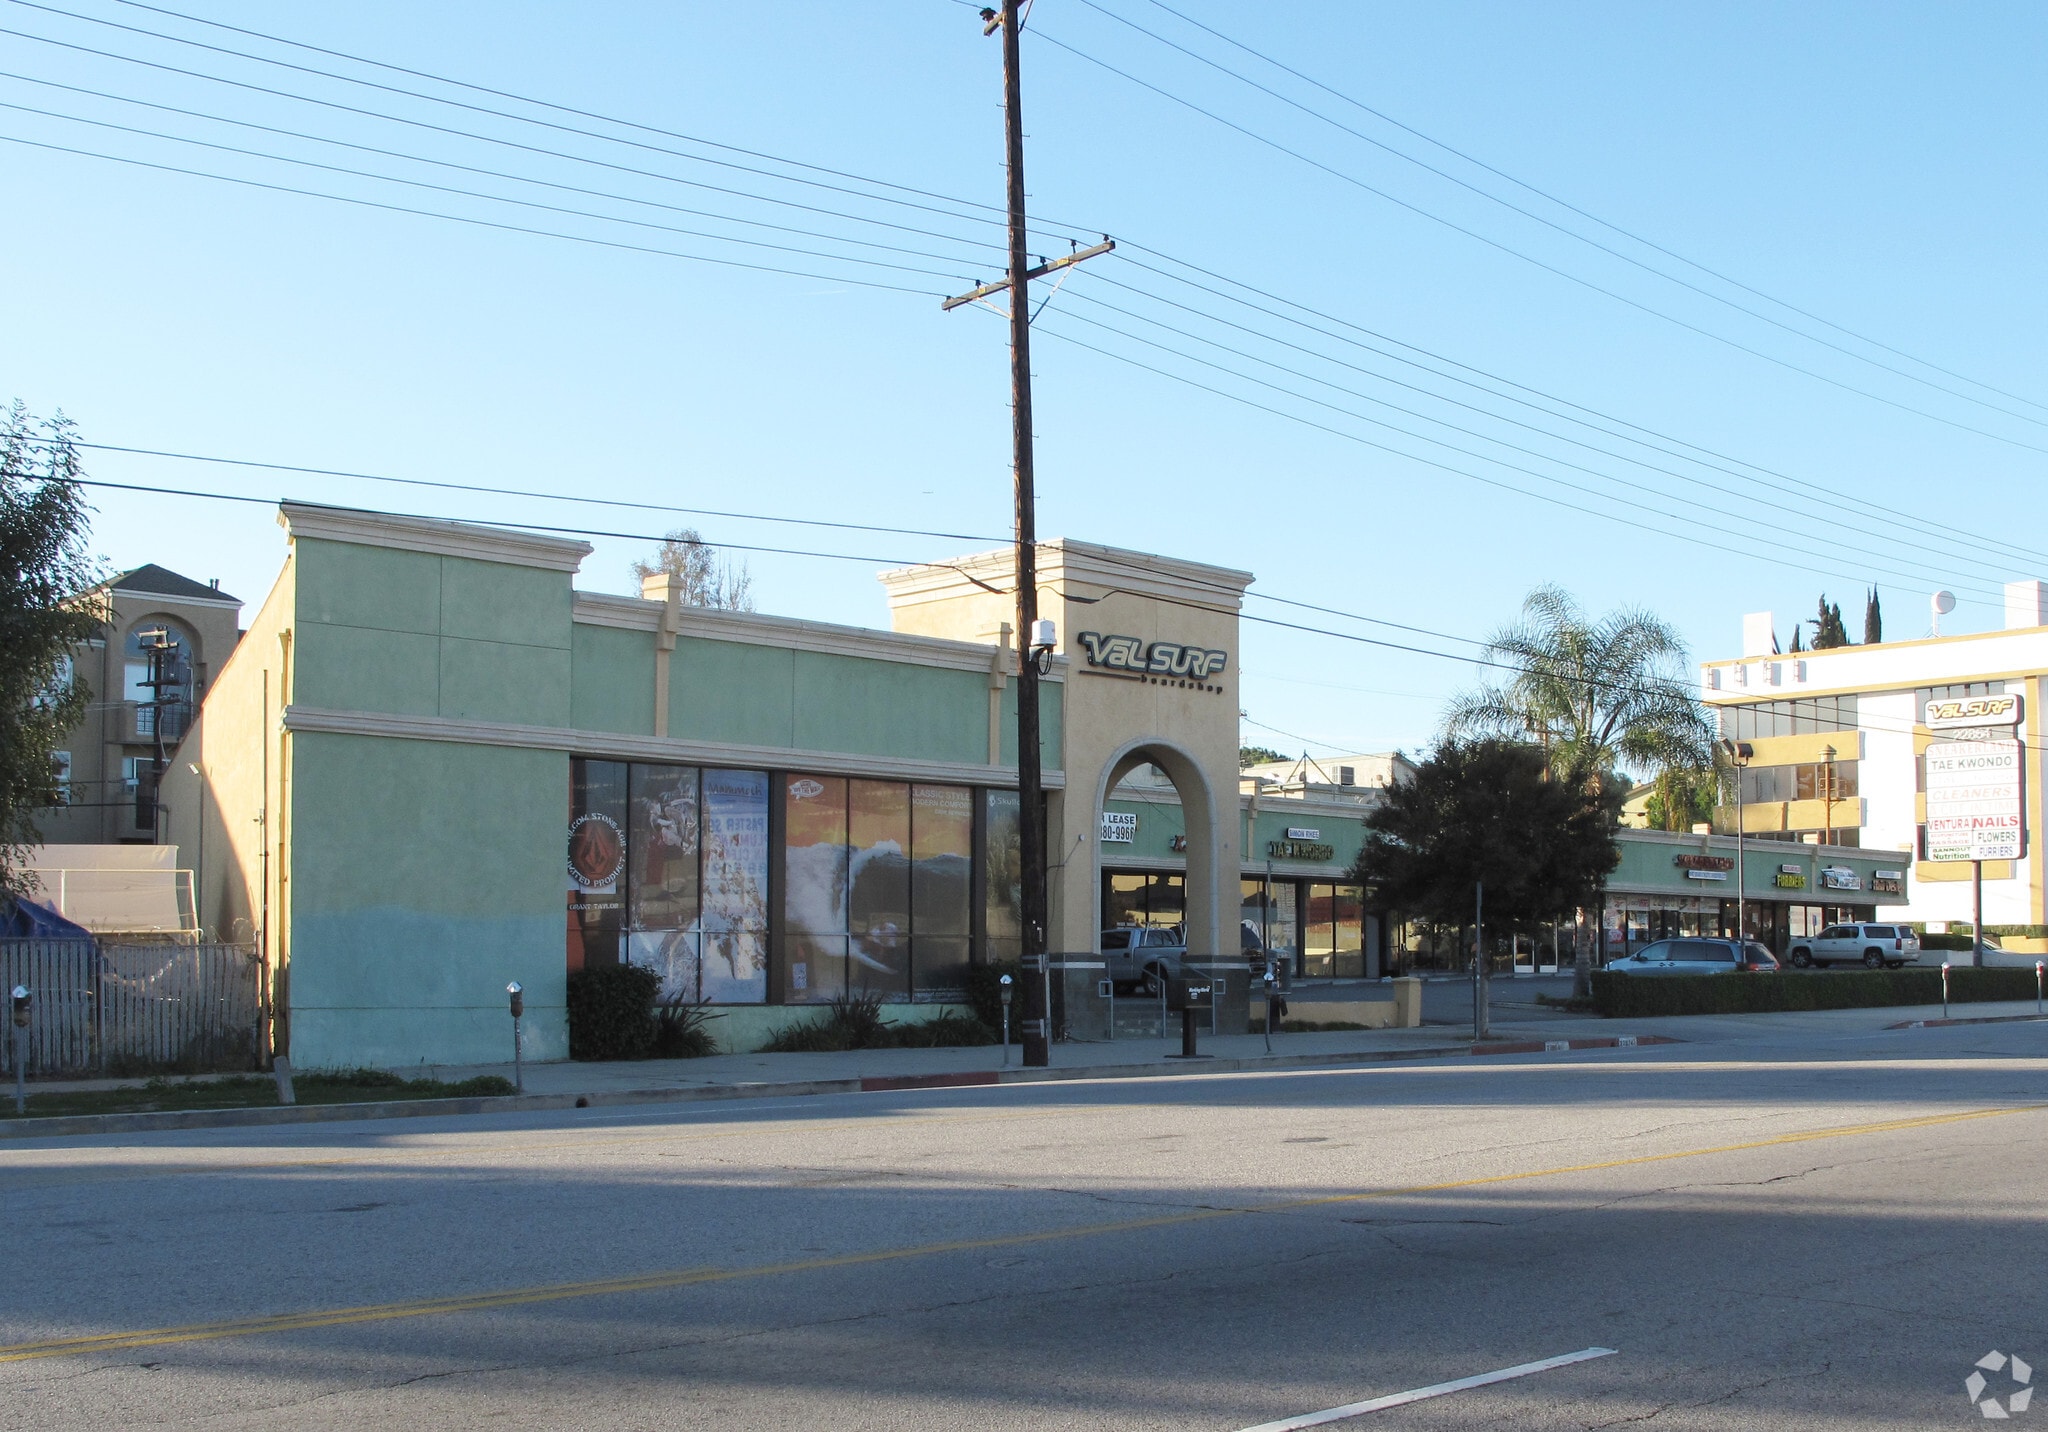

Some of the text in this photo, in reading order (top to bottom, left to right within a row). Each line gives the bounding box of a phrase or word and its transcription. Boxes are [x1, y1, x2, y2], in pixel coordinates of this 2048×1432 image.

[1147, 642, 1227, 680] SURF
[1141, 674, 1223, 695] boardshop
[1965, 699, 2015, 717] SURF
[1931, 756, 2013, 771] TAE KWONDO
[708, 783, 763, 797] Mammoth
[945, 791, 970, 801] STYLE
[1932, 786, 2012, 801] CLEANERS
[1108, 814, 1135, 825] LEASE
[1928, 815, 2019, 830] VENTURA NAILS
[568, 814, 589, 845] OLCOM
[1977, 831, 2016, 843] FLOWERS
[1932, 852, 1970, 860] Nutrition
[1979, 846, 2014, 857] FURRIERS
[593, 856, 626, 888] PRODUCT
[593, 902, 619, 910] TAYLOR
